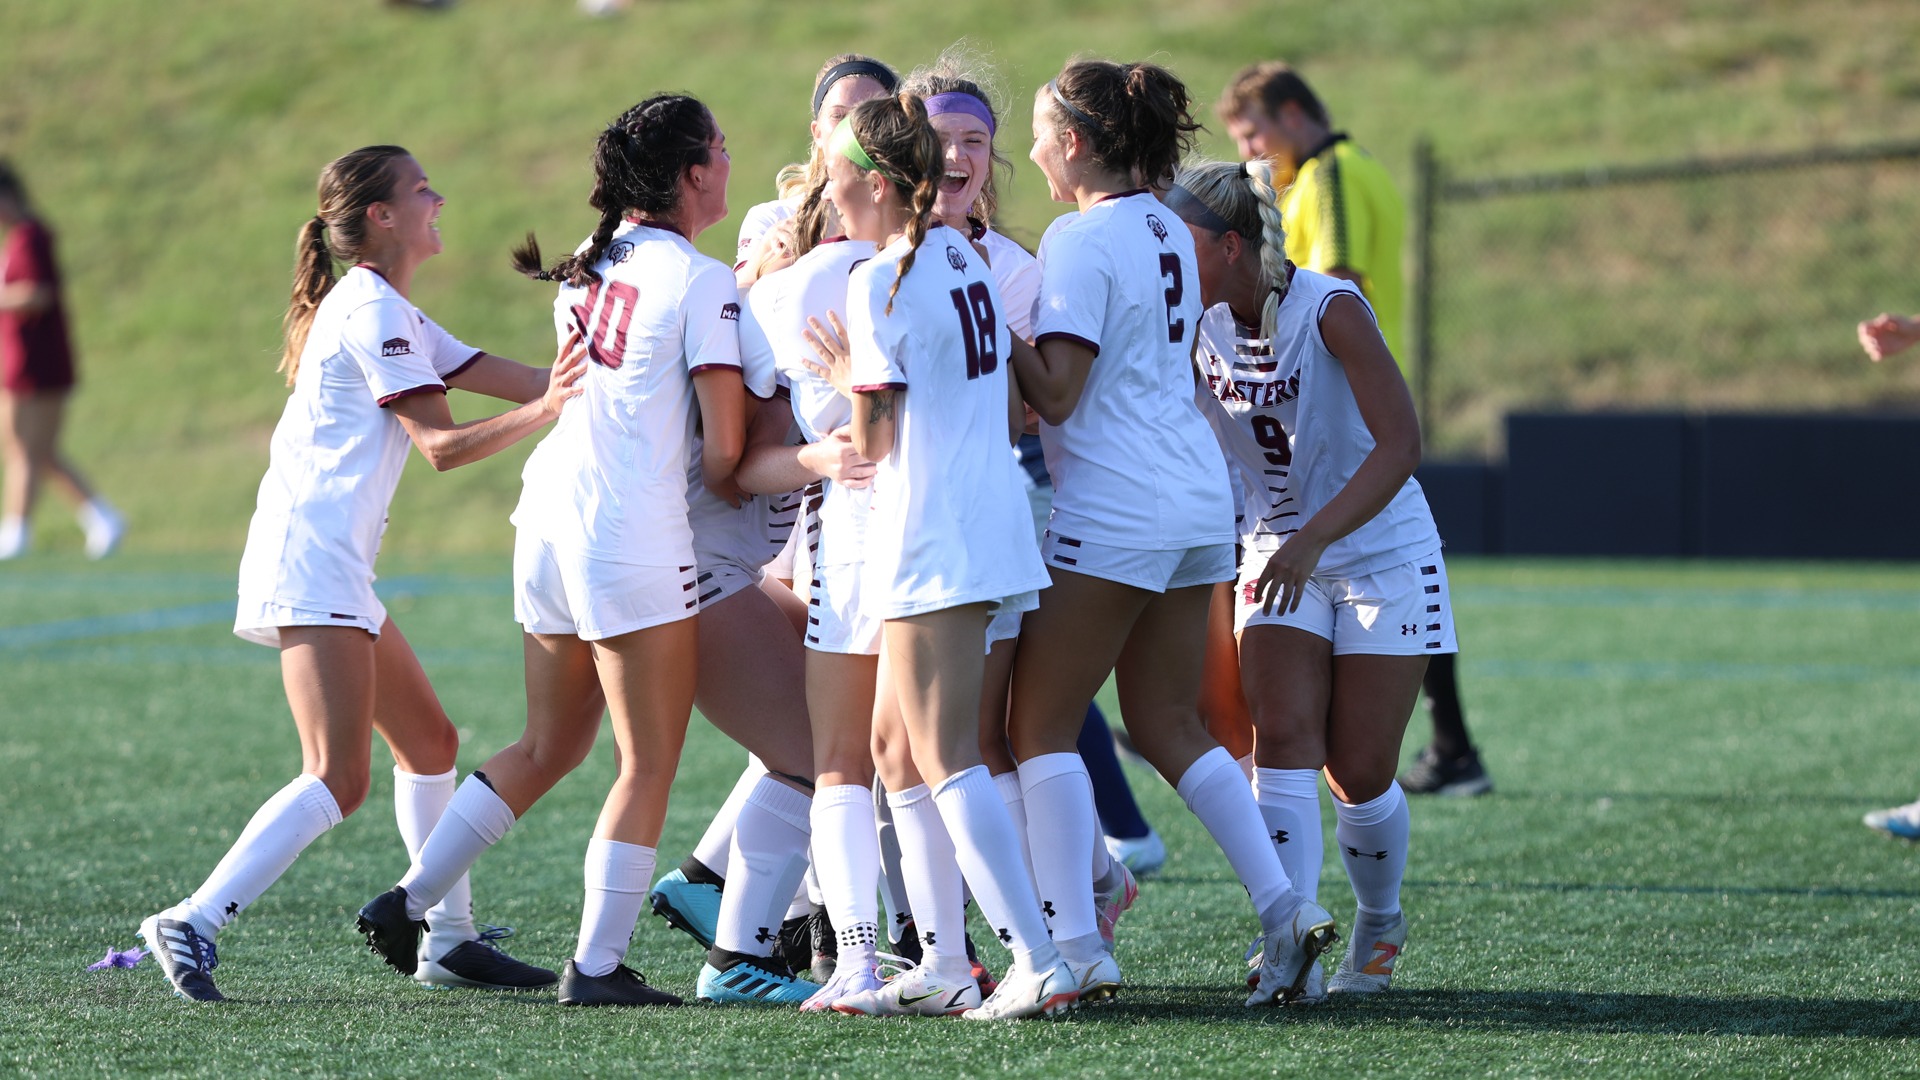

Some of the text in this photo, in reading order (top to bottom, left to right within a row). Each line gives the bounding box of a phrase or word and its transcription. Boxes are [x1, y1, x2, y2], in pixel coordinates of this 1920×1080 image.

[949, 280, 998, 380] 18
[1158, 252, 1185, 343] 2
[1206, 368, 1301, 408] EASTERN
[1251, 415, 1292, 467] 9
